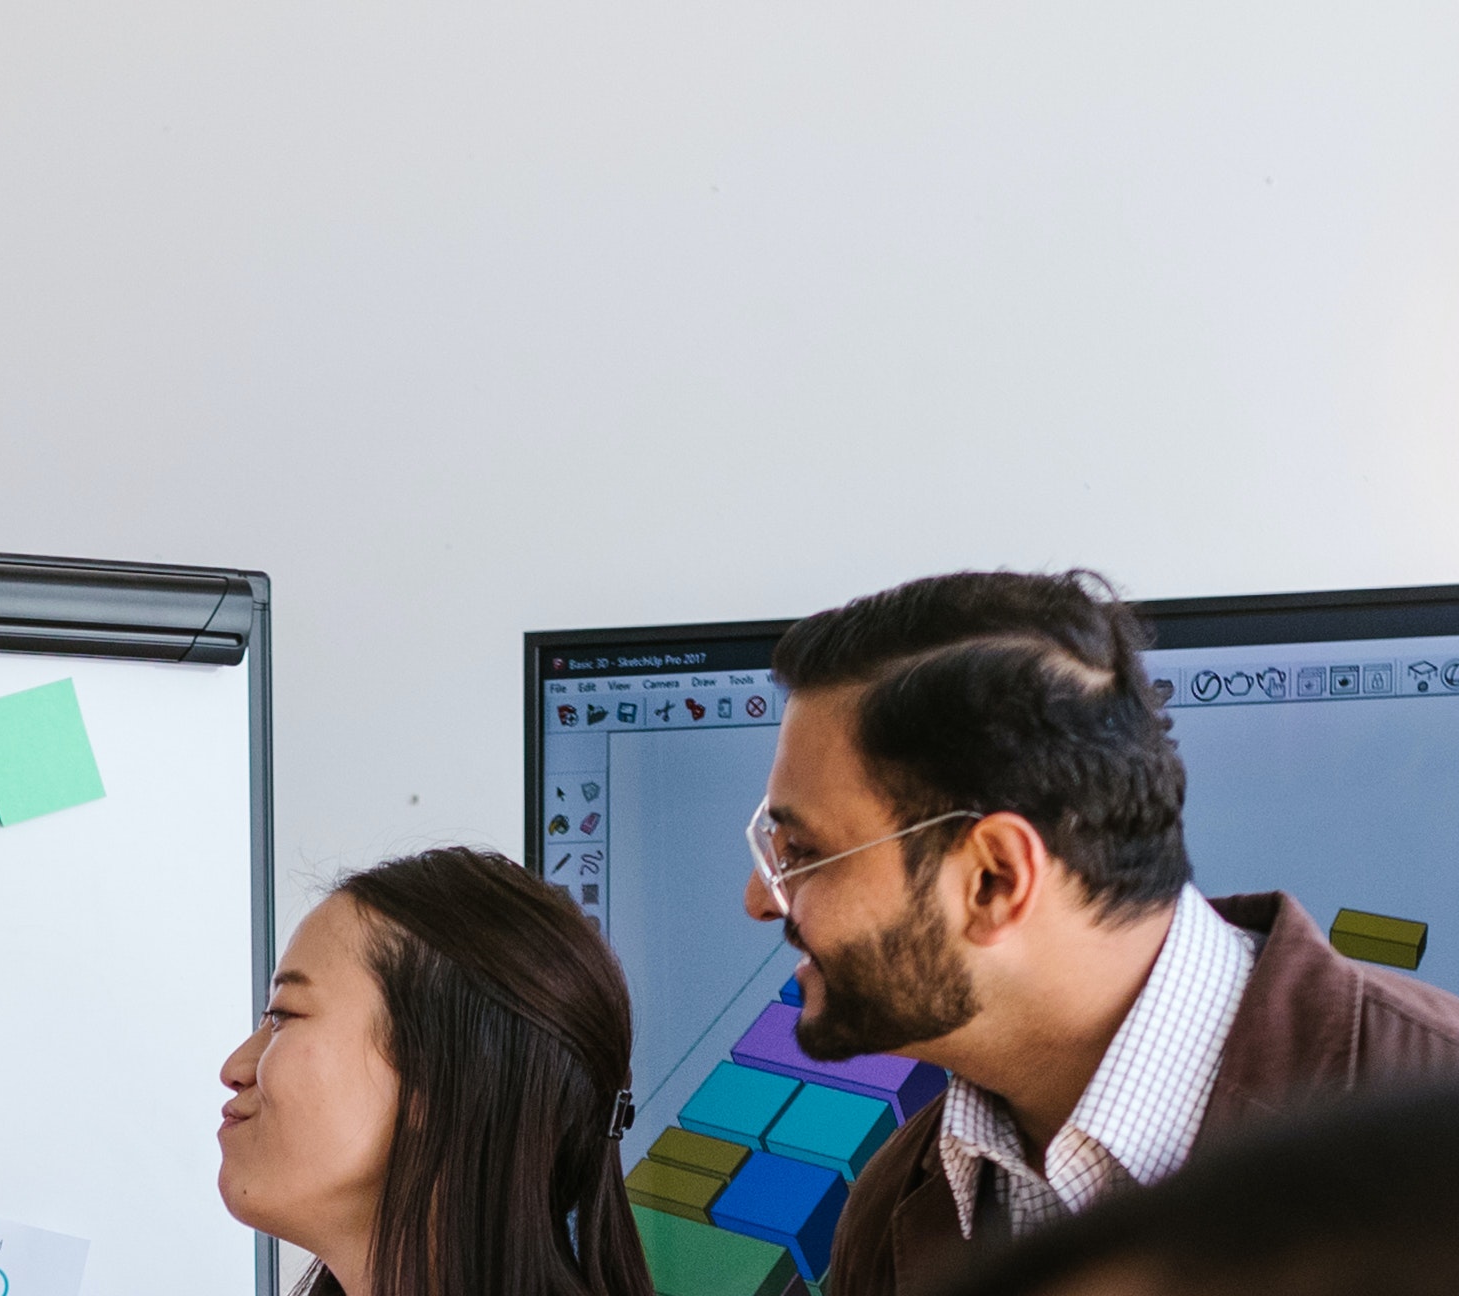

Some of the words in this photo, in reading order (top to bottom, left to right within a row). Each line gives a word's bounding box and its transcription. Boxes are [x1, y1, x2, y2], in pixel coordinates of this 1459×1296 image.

[569, 659, 593, 670] Basic
[596, 659, 609, 669] 3D
[618, 656, 663, 669] SketchUp
[665, 655, 681, 666] Pro
[684, 653, 706, 665] 2017
[550, 683, 567, 694] File
[578, 681, 596, 693] Edit
[608, 680, 632, 691] View
[643, 678, 680, 690] Camera
[691, 676, 717, 688] Draw
[729, 674, 755, 686] Tools
